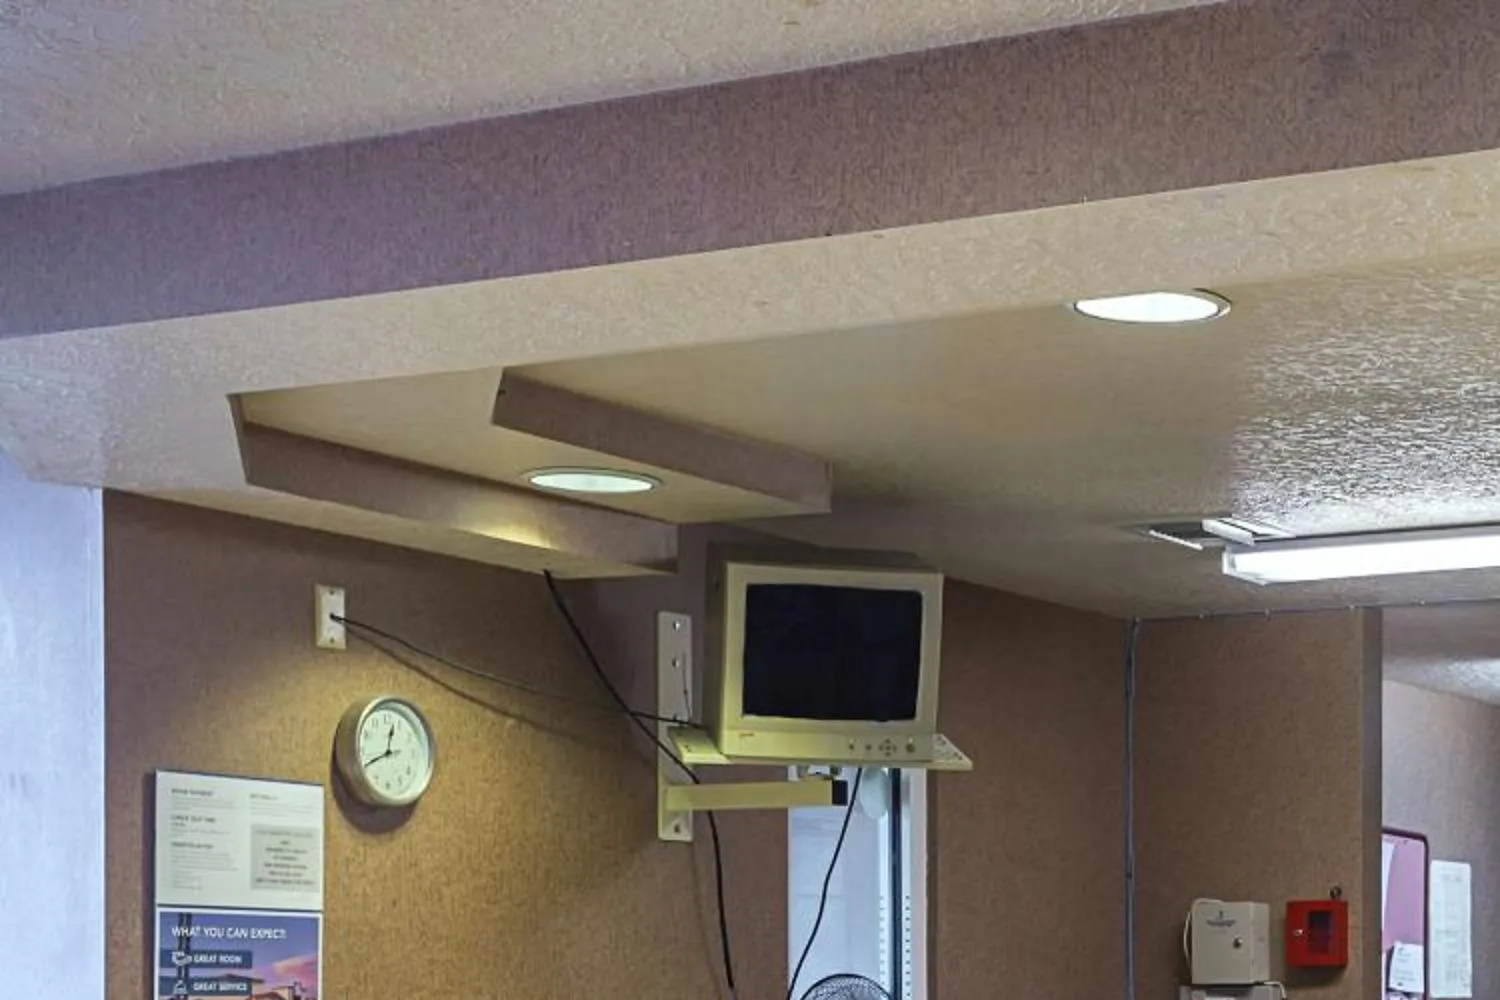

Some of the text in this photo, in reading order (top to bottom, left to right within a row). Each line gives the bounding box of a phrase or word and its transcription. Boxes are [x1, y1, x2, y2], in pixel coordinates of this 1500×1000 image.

[171, 926, 201, 937] WHAT
[203, 927, 225, 938] YOU
[226, 927, 248, 939] CAN
